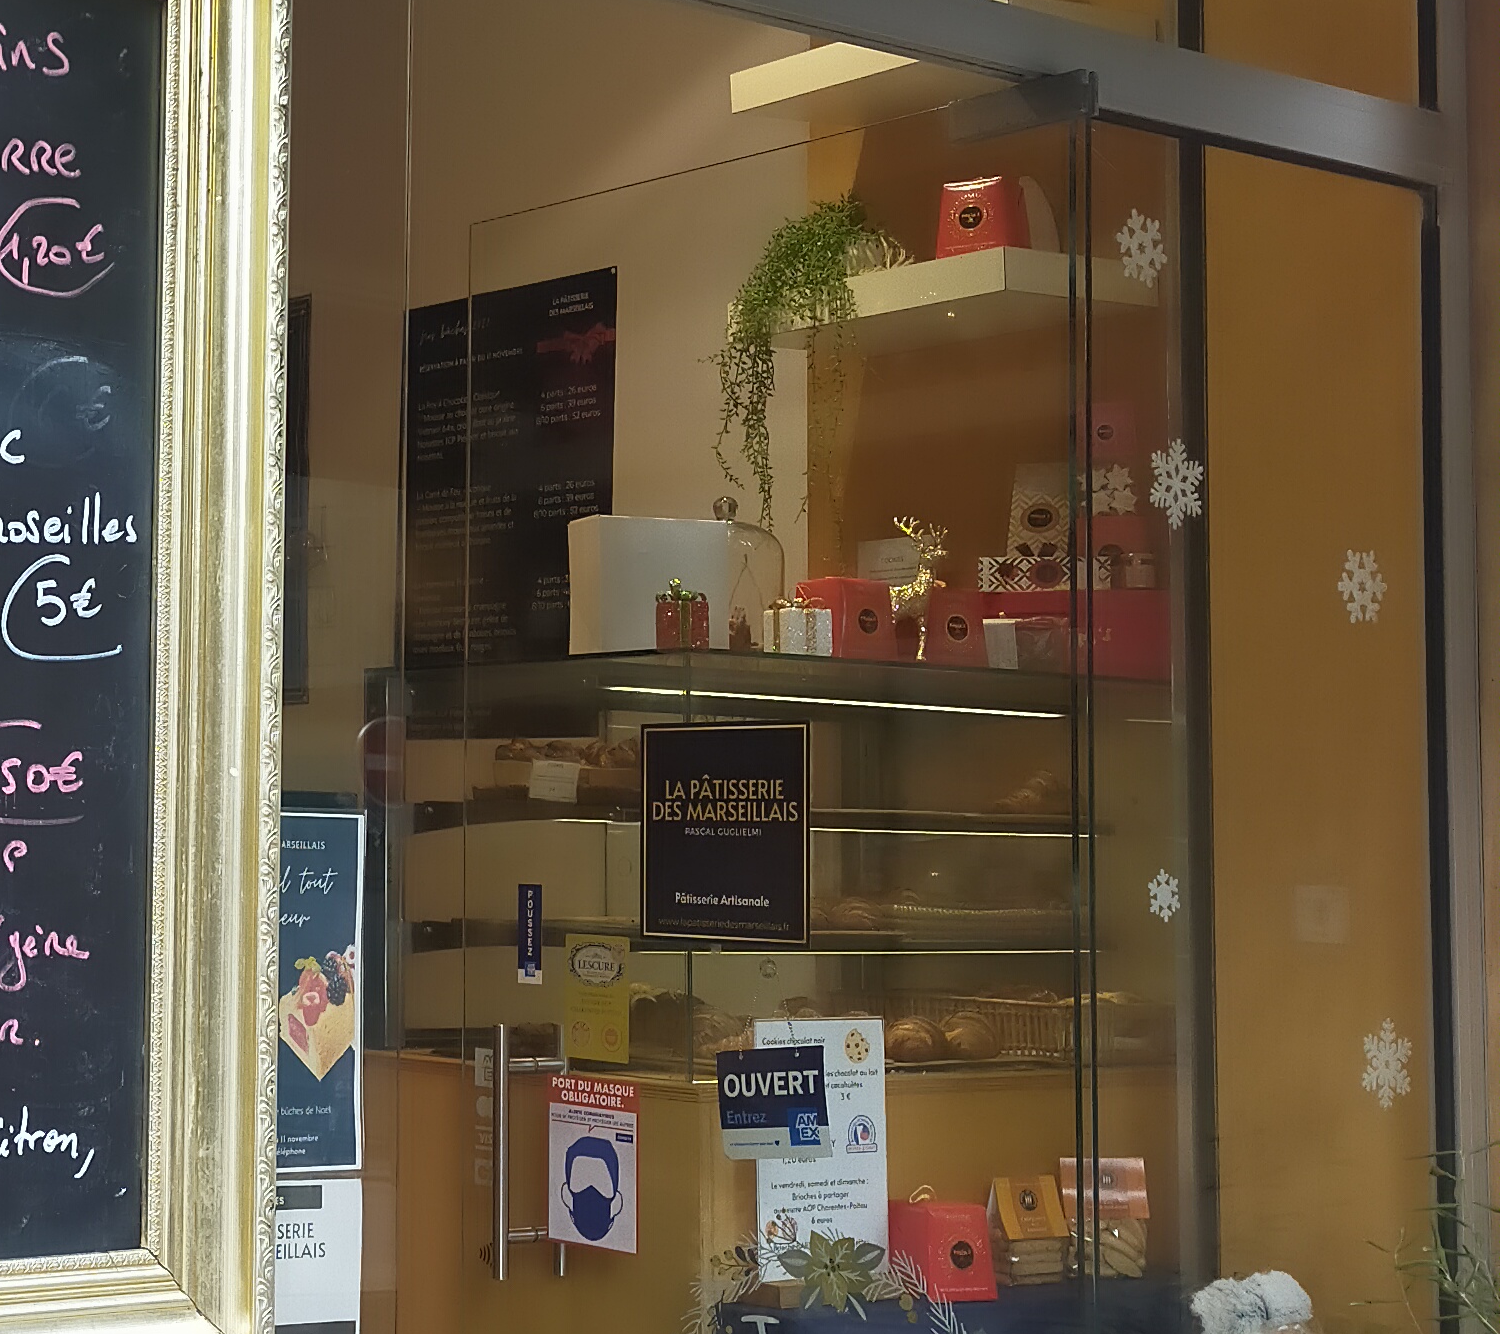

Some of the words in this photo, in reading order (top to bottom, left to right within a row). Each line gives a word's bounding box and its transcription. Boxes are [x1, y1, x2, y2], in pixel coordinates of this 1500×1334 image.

[36, 577, 104, 628] 5€
[665, 779, 686, 800] LA
[690, 774, 785, 800] PÂTISSERIE
[652, 802, 682, 821] DES
[686, 801, 799, 822] MARSEILLAIS
[684, 827, 716, 836] PASCAL
[280, 840, 326, 850] ARSEILLAIS
[298, 867, 339, 895] tout
[675, 892, 719, 906] Pâtisserie
[720, 894, 770, 908] Artisanale
[279, 913, 311, 927] eur
[526, 890, 535, 956] POUSSEZ
[761, 1037, 786, 1046] Cookies
[813, 1037, 826, 1045] noir
[552, 1076, 576, 1090] PORT
[577, 1080, 592, 1092] DU
[593, 1082, 634, 1098] MASQUE
[722, 1069, 820, 1098] OUVERT
[561, 1090, 625, 1108] OBLIGATOIRE.
[726, 1110, 768, 1125] Entrez
[287, 1134, 319, 1143] novembre
[276, 1147, 306, 1157] éléphone
[770, 1182, 778, 1190] Le
[807, 1179, 829, 1188] samedi
[829, 1179, 836, 1187] et
[791, 1192, 817, 1201] Brioches
[823, 1192, 850, 1200] partager
[277, 1222, 314, 1240] SERIE
[275, 1241, 326, 1260] EILLAIS
